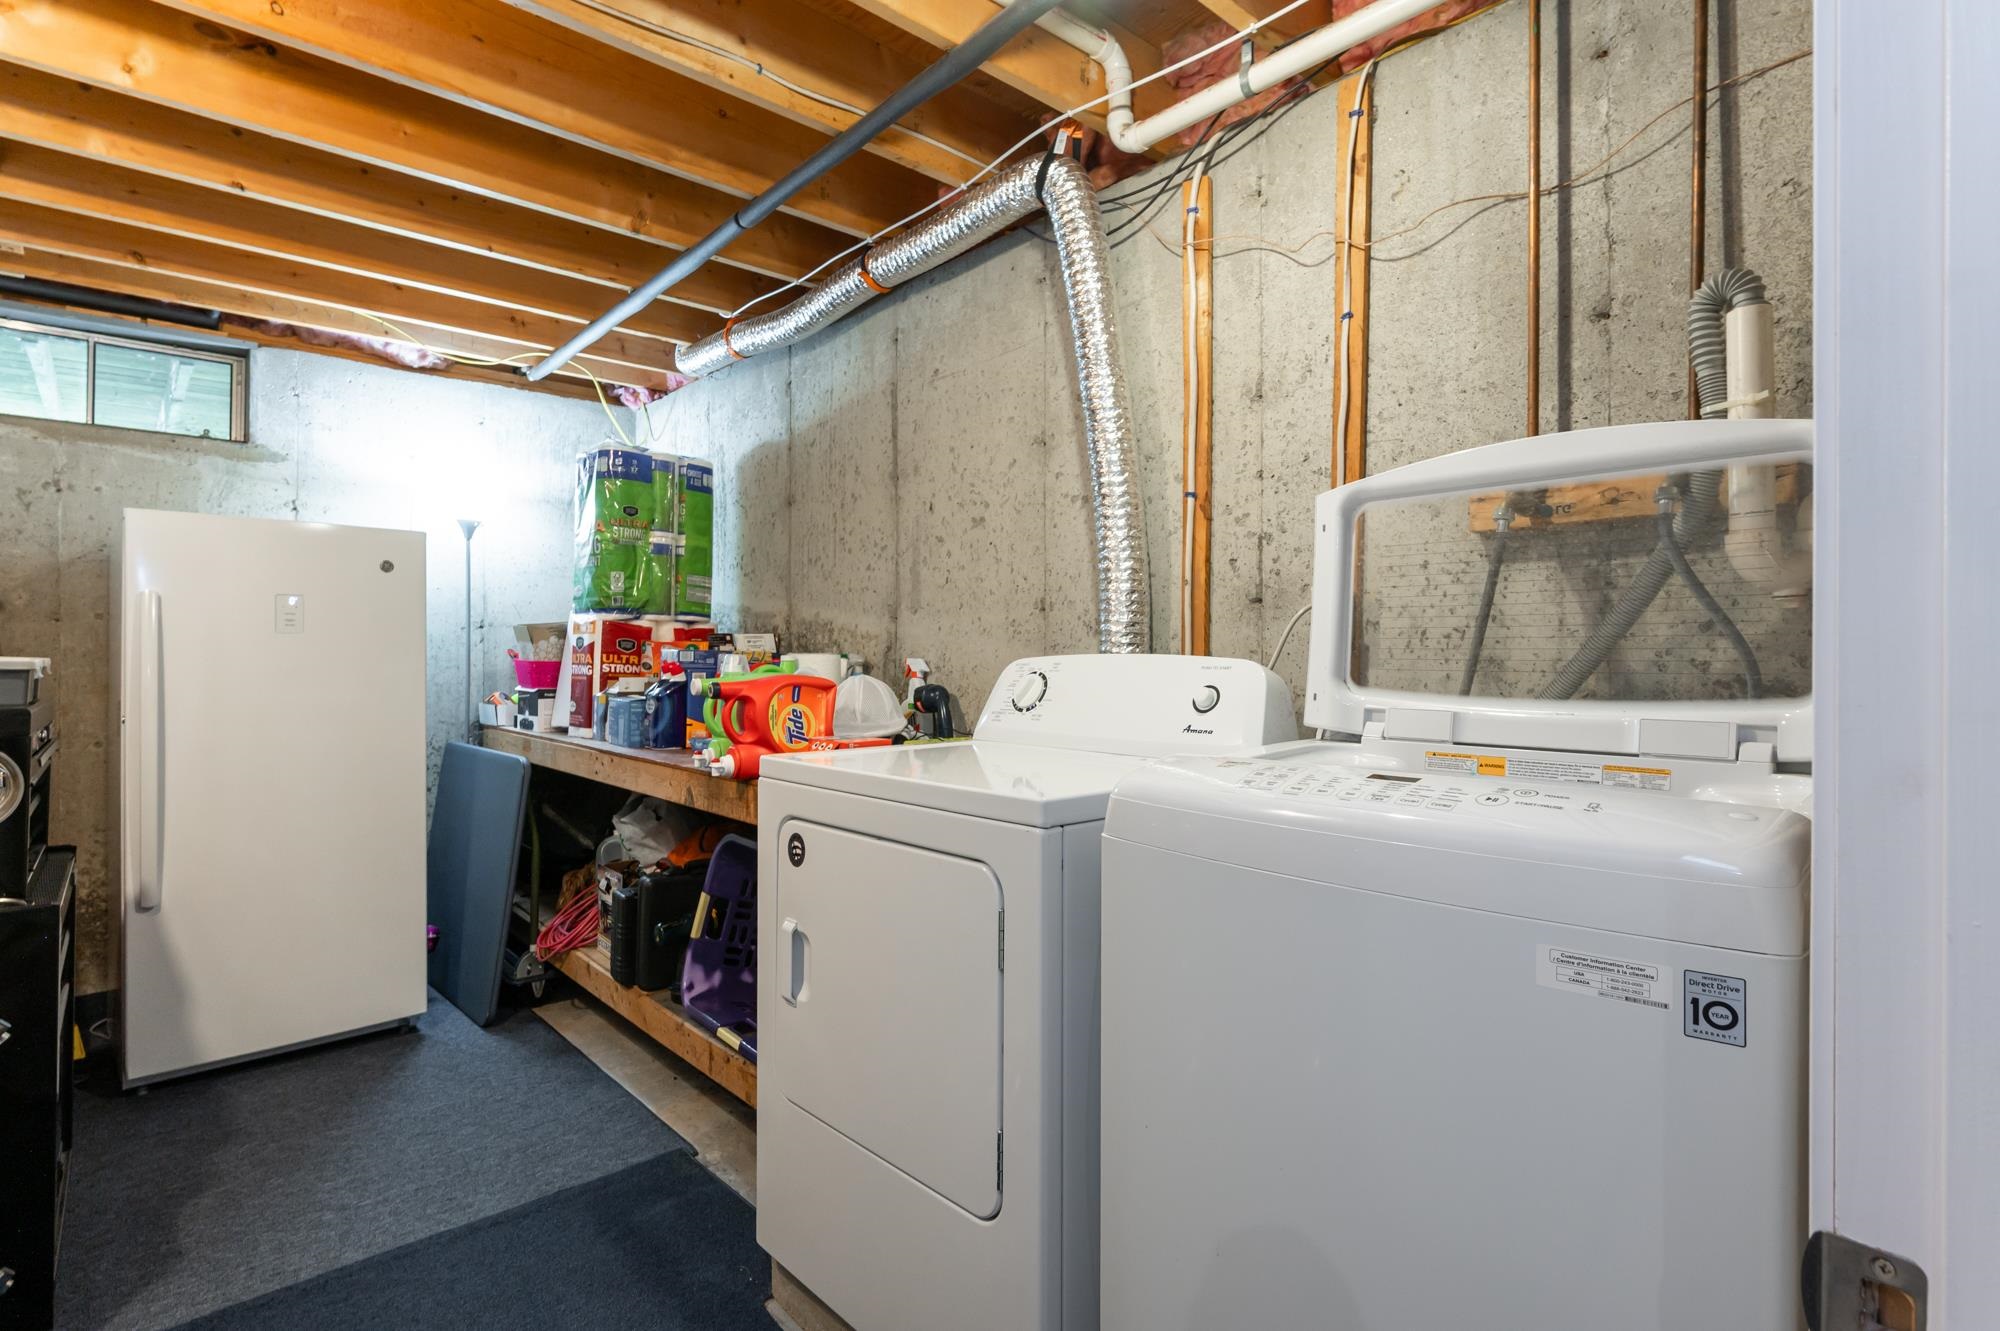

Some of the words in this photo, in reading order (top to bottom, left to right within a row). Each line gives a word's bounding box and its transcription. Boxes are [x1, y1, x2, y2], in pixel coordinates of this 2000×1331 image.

[602, 653, 639, 664] ULTR
[602, 663, 641, 674] STRON
[785, 707, 809, 744] Tide
[1182, 724, 1214, 735] Amana
[1556, 957, 1575, 965] Centre
[1560, 952, 1589, 961] Customer
[1590, 958, 1624, 968] Information
[1568, 977, 1591, 985] CANADA
[1689, 978, 1715, 989] Direct
[1716, 983, 1741, 993] Drive
[1702, 988, 1727, 996] MOTOR
[1690, 997, 1739, 1031] 10
[1711, 1011, 1730, 1020] YEAR
[1693, 1029, 1737, 1040] WARRANTY
